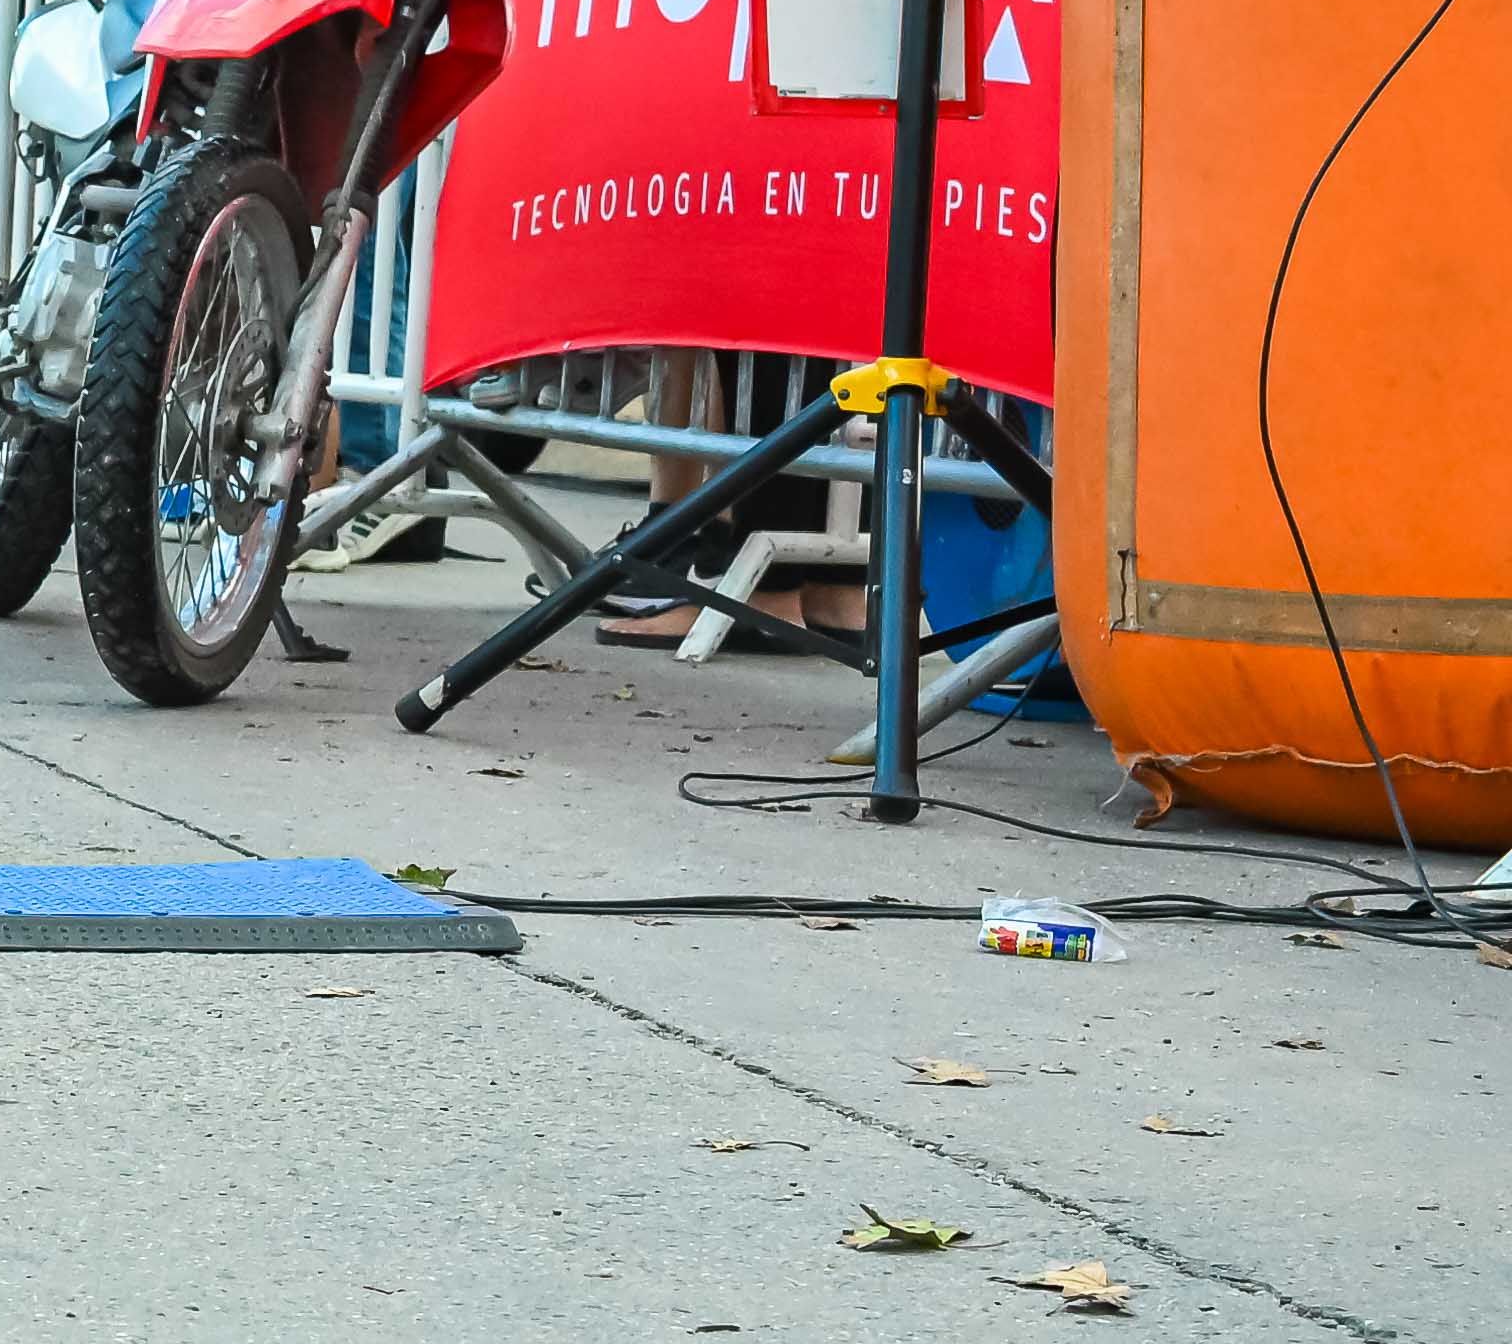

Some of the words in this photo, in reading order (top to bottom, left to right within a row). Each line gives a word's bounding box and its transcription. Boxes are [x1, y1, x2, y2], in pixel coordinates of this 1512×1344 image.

[511, 171, 734, 241] TECNOLOGIA
[765, 171, 806, 216] EN
[834, 173, 879, 219] TU
[944, 181, 1048, 244] PIES
